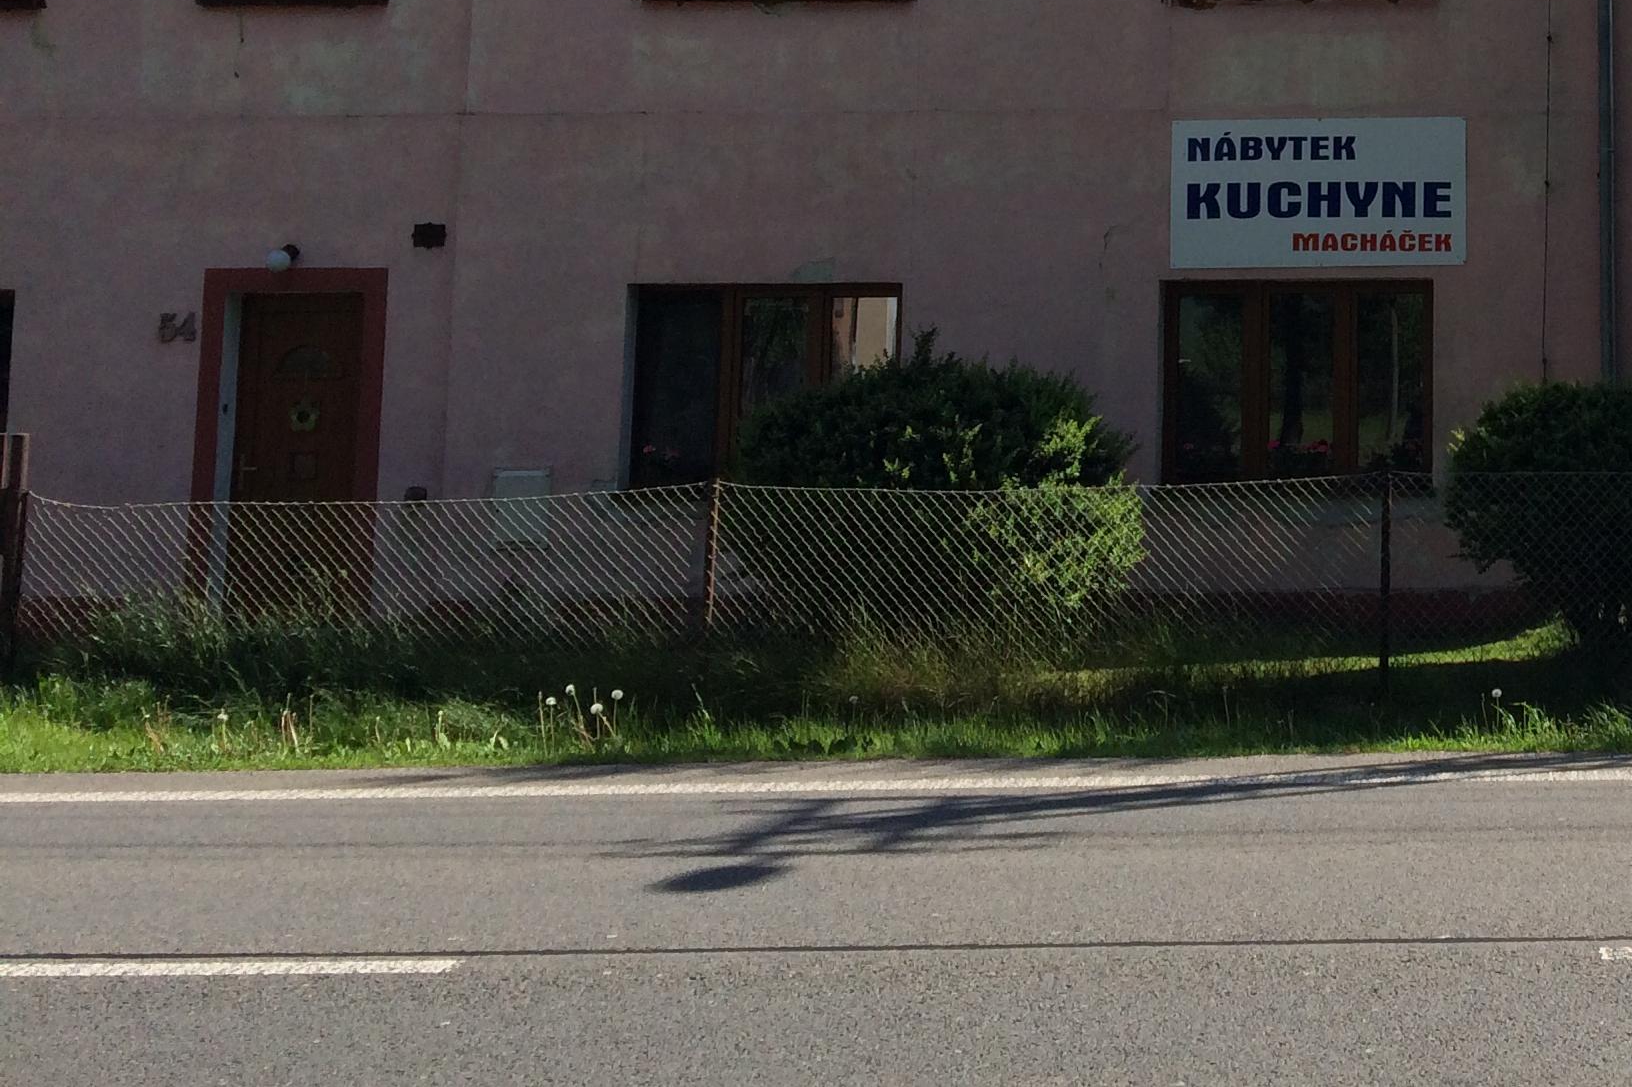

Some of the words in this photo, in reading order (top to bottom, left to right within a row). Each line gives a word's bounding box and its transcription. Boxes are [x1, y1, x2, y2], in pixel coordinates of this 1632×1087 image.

[1187, 132, 1356, 162] NÁBYTEK
[1187, 181, 1452, 219] KUCHYNE
[1292, 229, 1452, 252] MACHÁČEK
